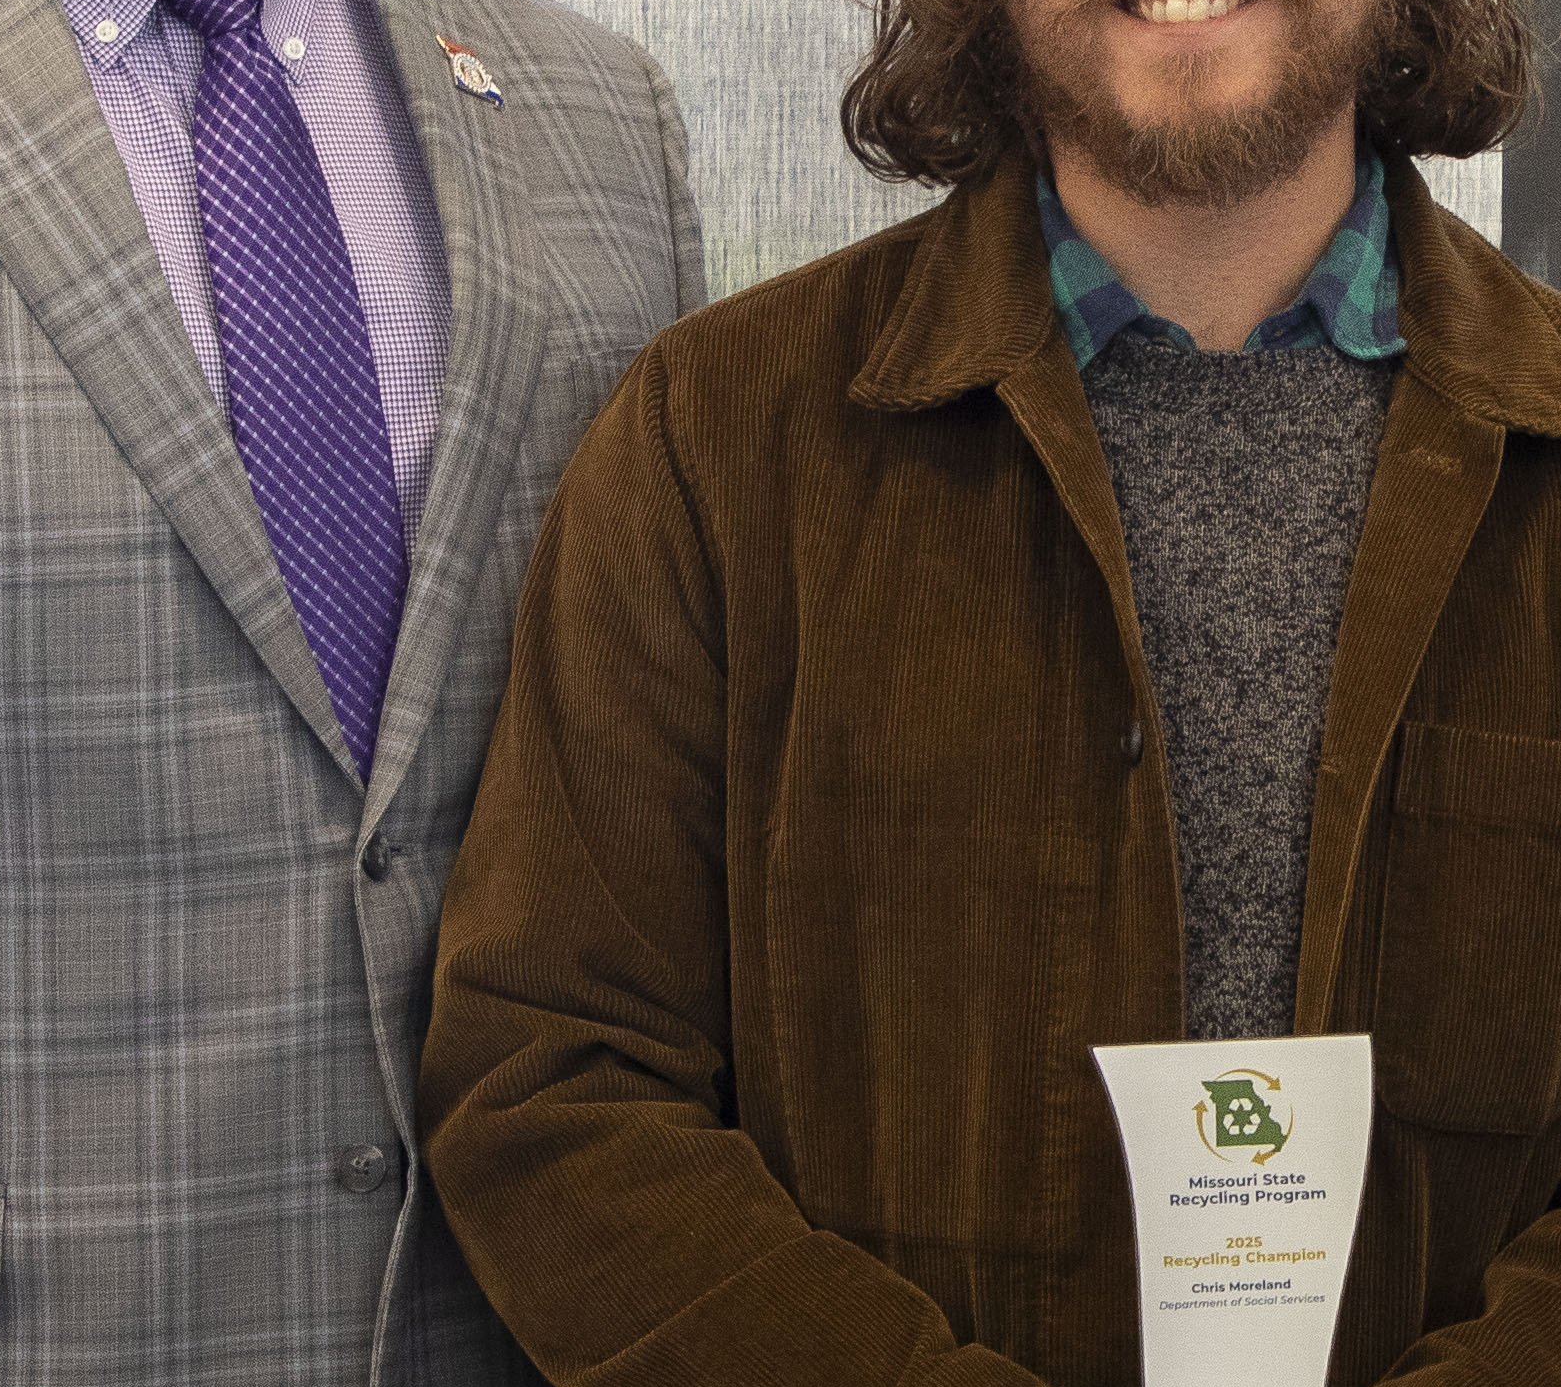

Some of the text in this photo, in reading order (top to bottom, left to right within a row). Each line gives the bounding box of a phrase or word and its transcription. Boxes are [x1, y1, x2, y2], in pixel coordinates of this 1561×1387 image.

[1189, 1173, 1305, 1189] Missouri State
[1170, 1190, 1326, 1208] Recycling Program
[1226, 1236, 1263, 1249] 2025
[1163, 1249, 1326, 1268] Recycling Champion
[1191, 1279, 1291, 1293] Chris Moreland
[1159, 1293, 1326, 1311] Department of Social Services
